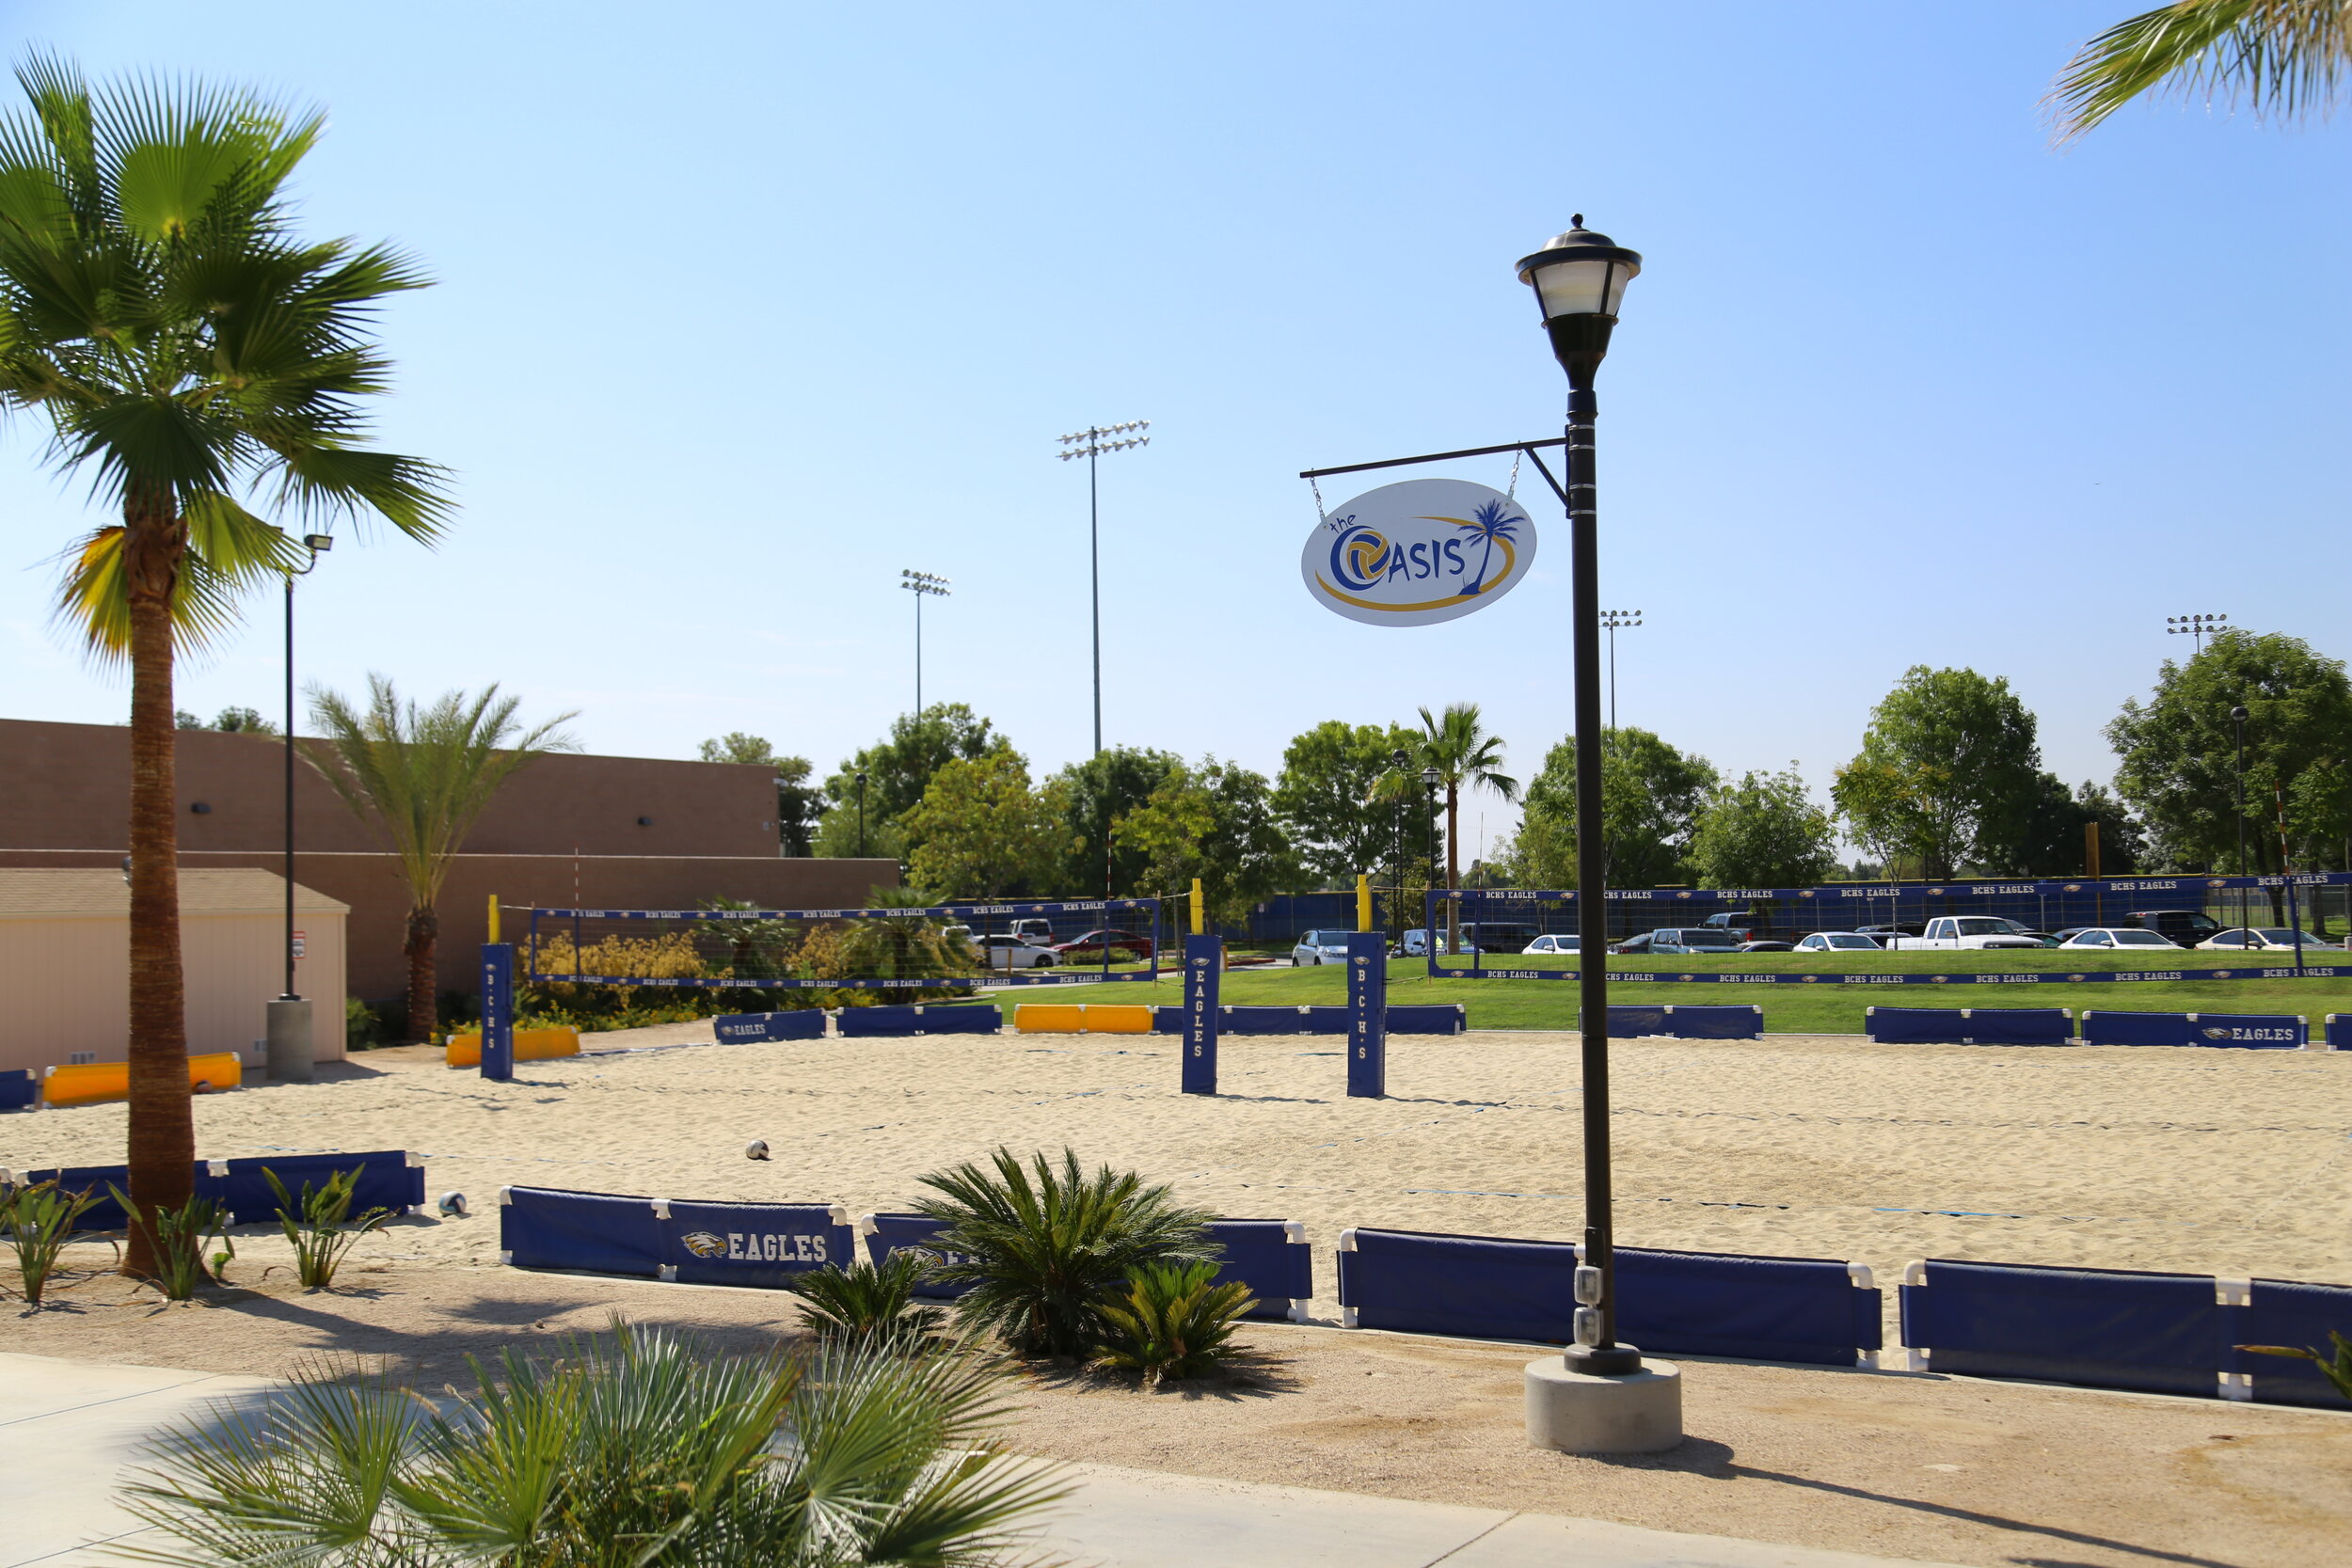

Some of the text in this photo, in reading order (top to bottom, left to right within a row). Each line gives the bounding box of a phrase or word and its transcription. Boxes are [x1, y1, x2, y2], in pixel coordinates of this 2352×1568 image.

[1329, 514, 1357, 534] the
[2110, 880, 2177, 891] BCHS EAGLES
[2258, 877, 2284, 885] BCHS
[1841, 889, 1864, 897] BCHS
[1972, 885, 2035, 895] BCHS EAGLES
[1486, 891, 1537, 899] BCHS EAGLES
[1621, 891, 1652, 899] EAGLES
[973, 905, 1014, 914] BCHS EAGLES
[1062, 902, 1105, 911] BCHS EAGLES
[1487, 970, 1539, 979] BCHS EAGLES
[1605, 973, 1655, 981] CHS EAGLES
[2115, 972, 2182, 981] BCHS EAGLES
[2263, 969, 2289, 977] BCHS
[969, 978, 986, 987] BCHS
[1059, 974, 1102, 984] BCHS EAGLES
[1719, 974, 1776, 983] BCHS EAGLES
[1844, 975, 1904, 984] BCHS EAGLES
[1976, 974, 2039, 983] BCHS EAGLES
[817, 979, 838, 988] EAGLES
[1194, 970, 1205, 1057] EAGLES
[734, 1023, 766, 1036] EAGLES
[2232, 1027, 2295, 1040] EAGLES
[727, 1232, 827, 1262] EAGLES
